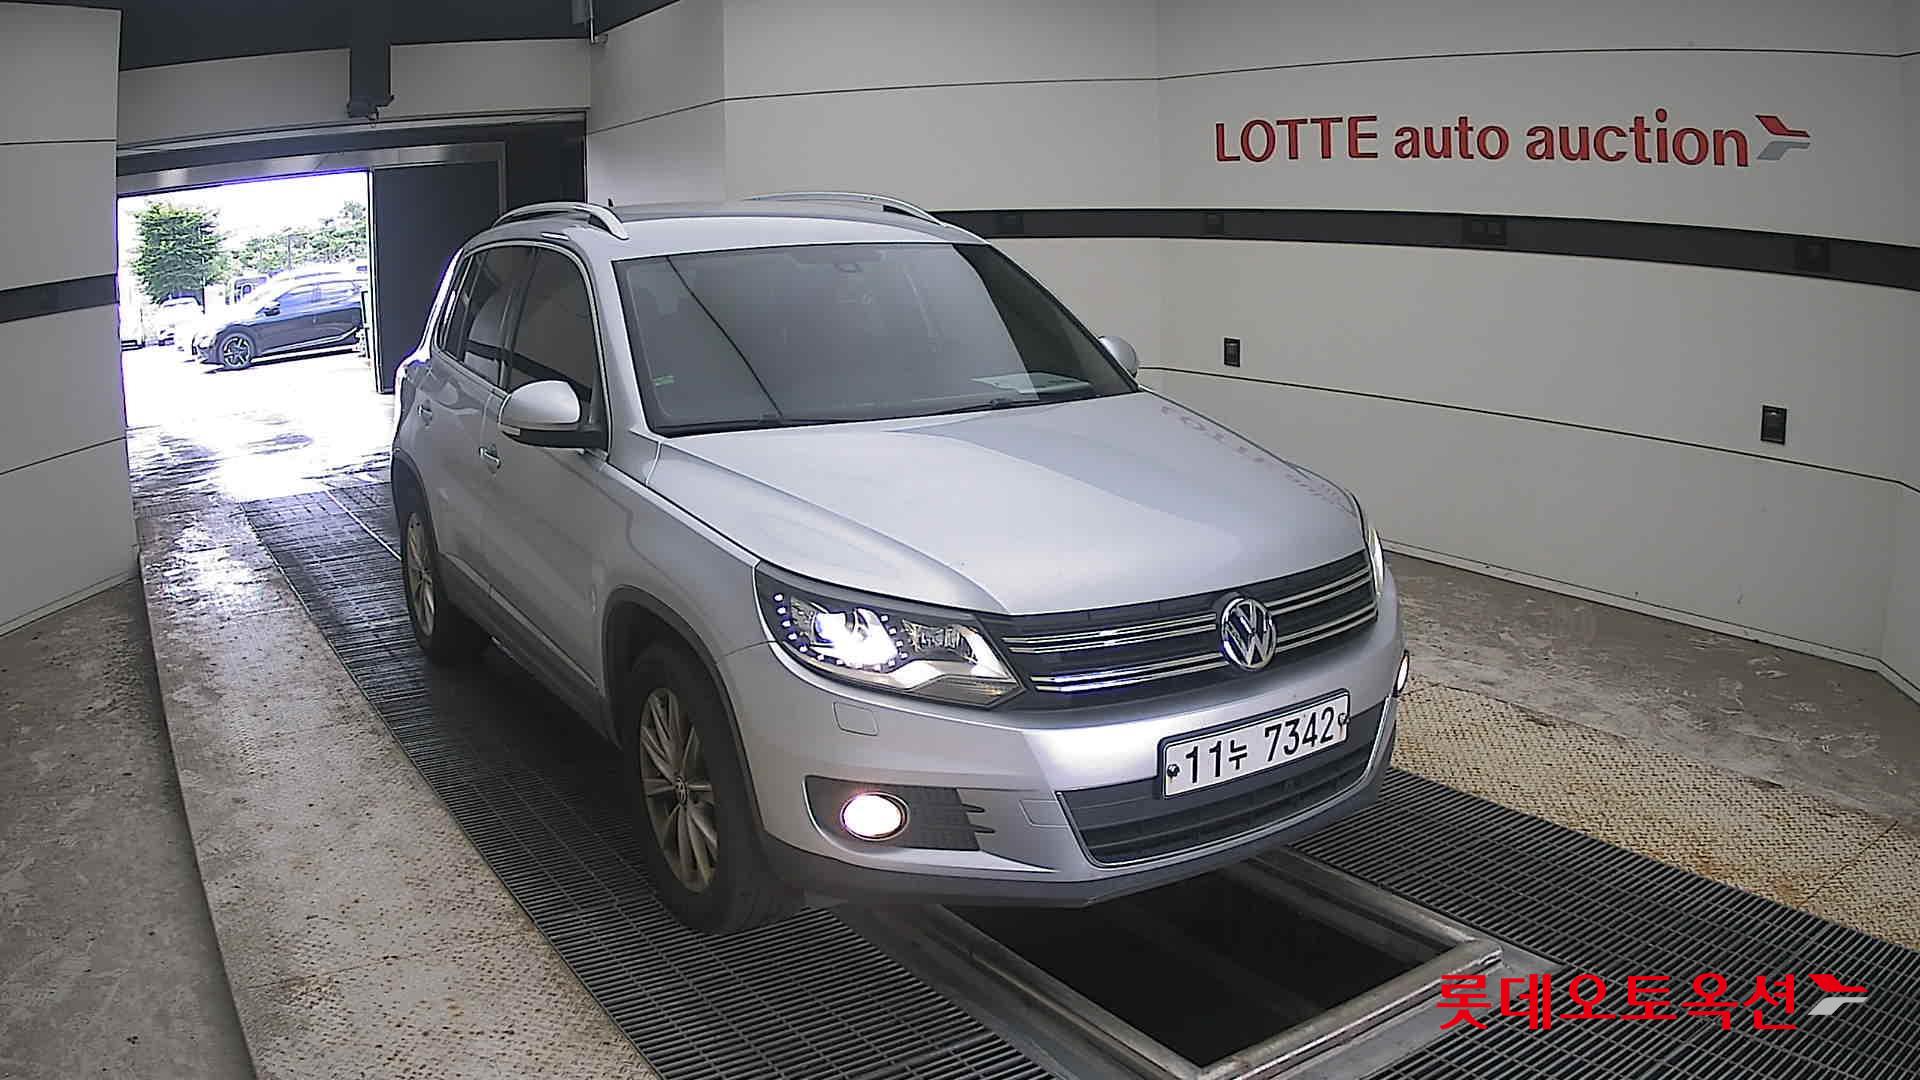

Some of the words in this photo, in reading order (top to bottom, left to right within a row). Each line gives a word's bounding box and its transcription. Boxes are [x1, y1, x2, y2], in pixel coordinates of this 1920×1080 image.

[1215, 115, 1379, 163] LOTTE
[1393, 115, 1510, 161] auto
[1525, 108, 1750, 168] auction
[1184, 739, 1248, 784] 11누
[1264, 706, 1335, 762] 7342
